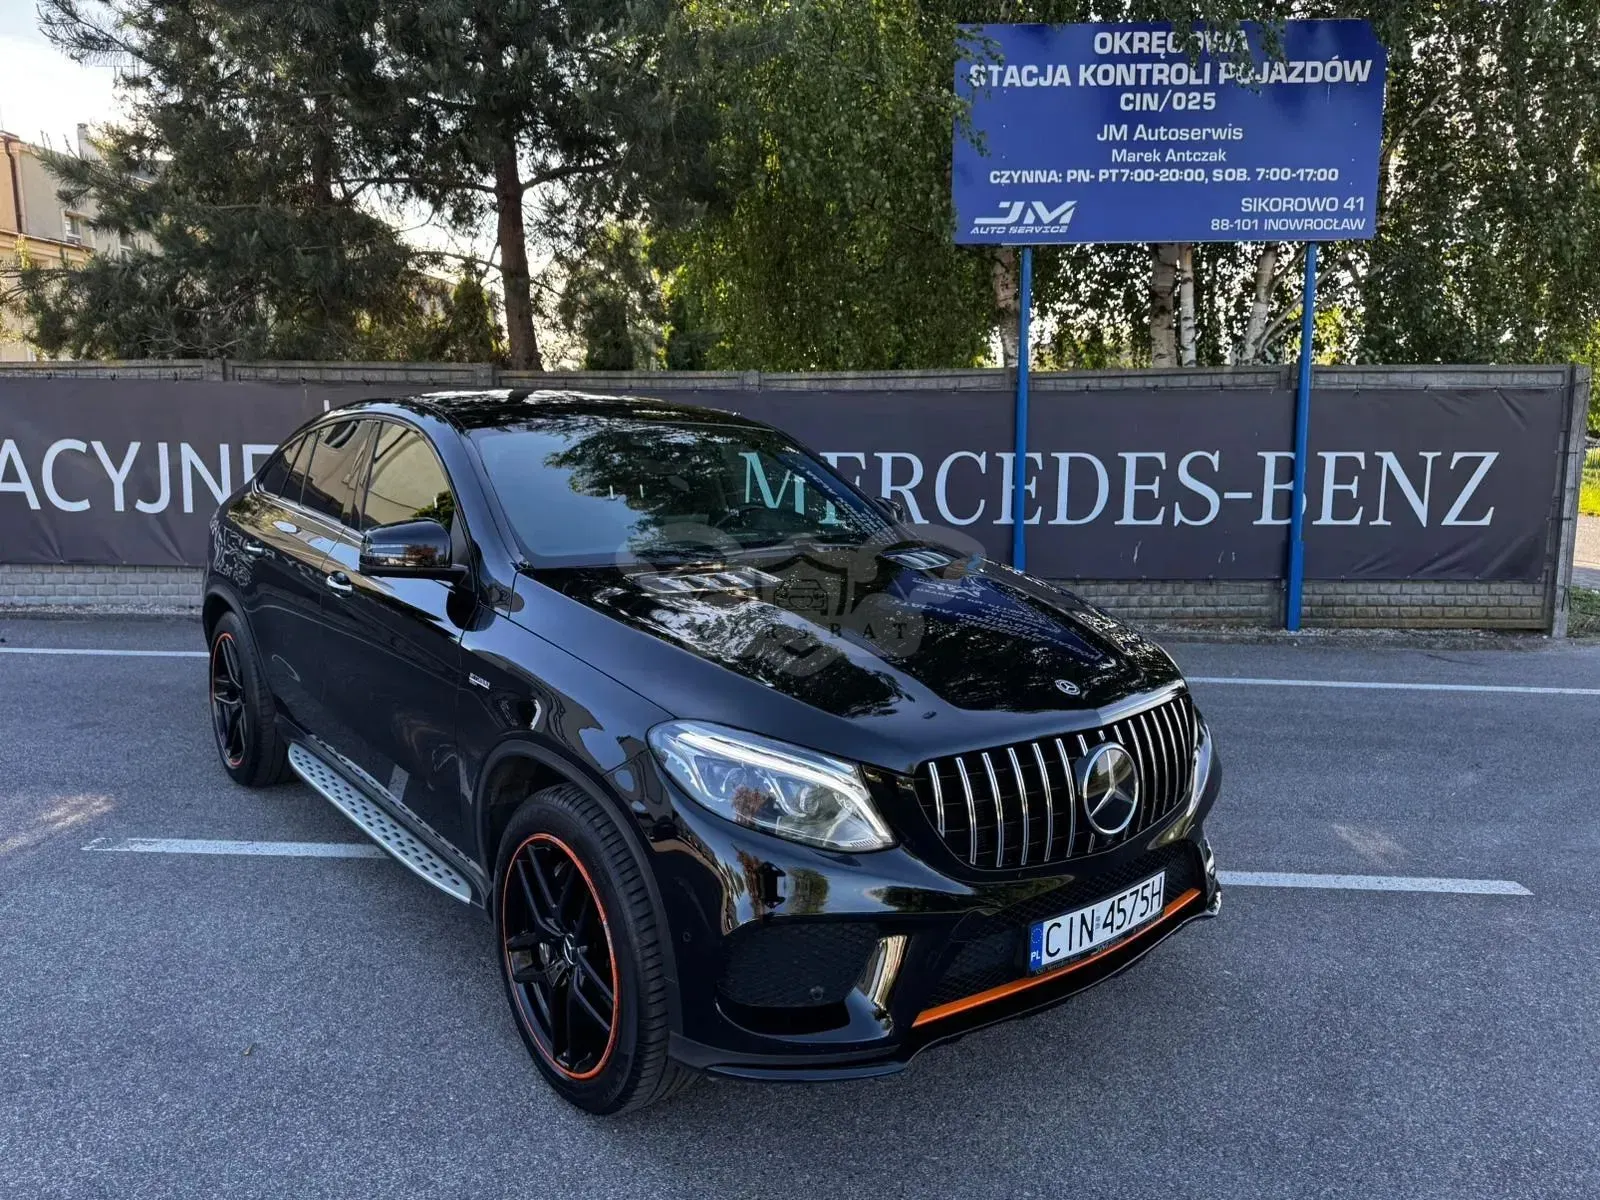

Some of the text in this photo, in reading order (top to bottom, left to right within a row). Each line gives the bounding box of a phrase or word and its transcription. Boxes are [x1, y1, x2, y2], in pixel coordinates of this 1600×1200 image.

[970, 64, 1071, 87] STACJA
[1079, 62, 1210, 87] KONTROLI
[1120, 89, 1216, 112] CIN/025
[1097, 123, 1244, 141] JM Autoserwis
[1111, 148, 1227, 162] Marek Antczak
[989, 170, 1063, 184] CZYNNA:
[1212, 168, 1251, 182] SOB.
[1255, 168, 1339, 181] 7:00-17:00
[974, 201, 1078, 224] JM
[1241, 197, 1365, 212] SIKOROWO 41
[970, 226, 1069, 235] AUTO SERVICE
[1211, 218, 1366, 231] 88-101 INOWROCŁAW
[1045, 876, 1163, 957] CIN 4575H
[1030, 951, 1041, 962] PL
